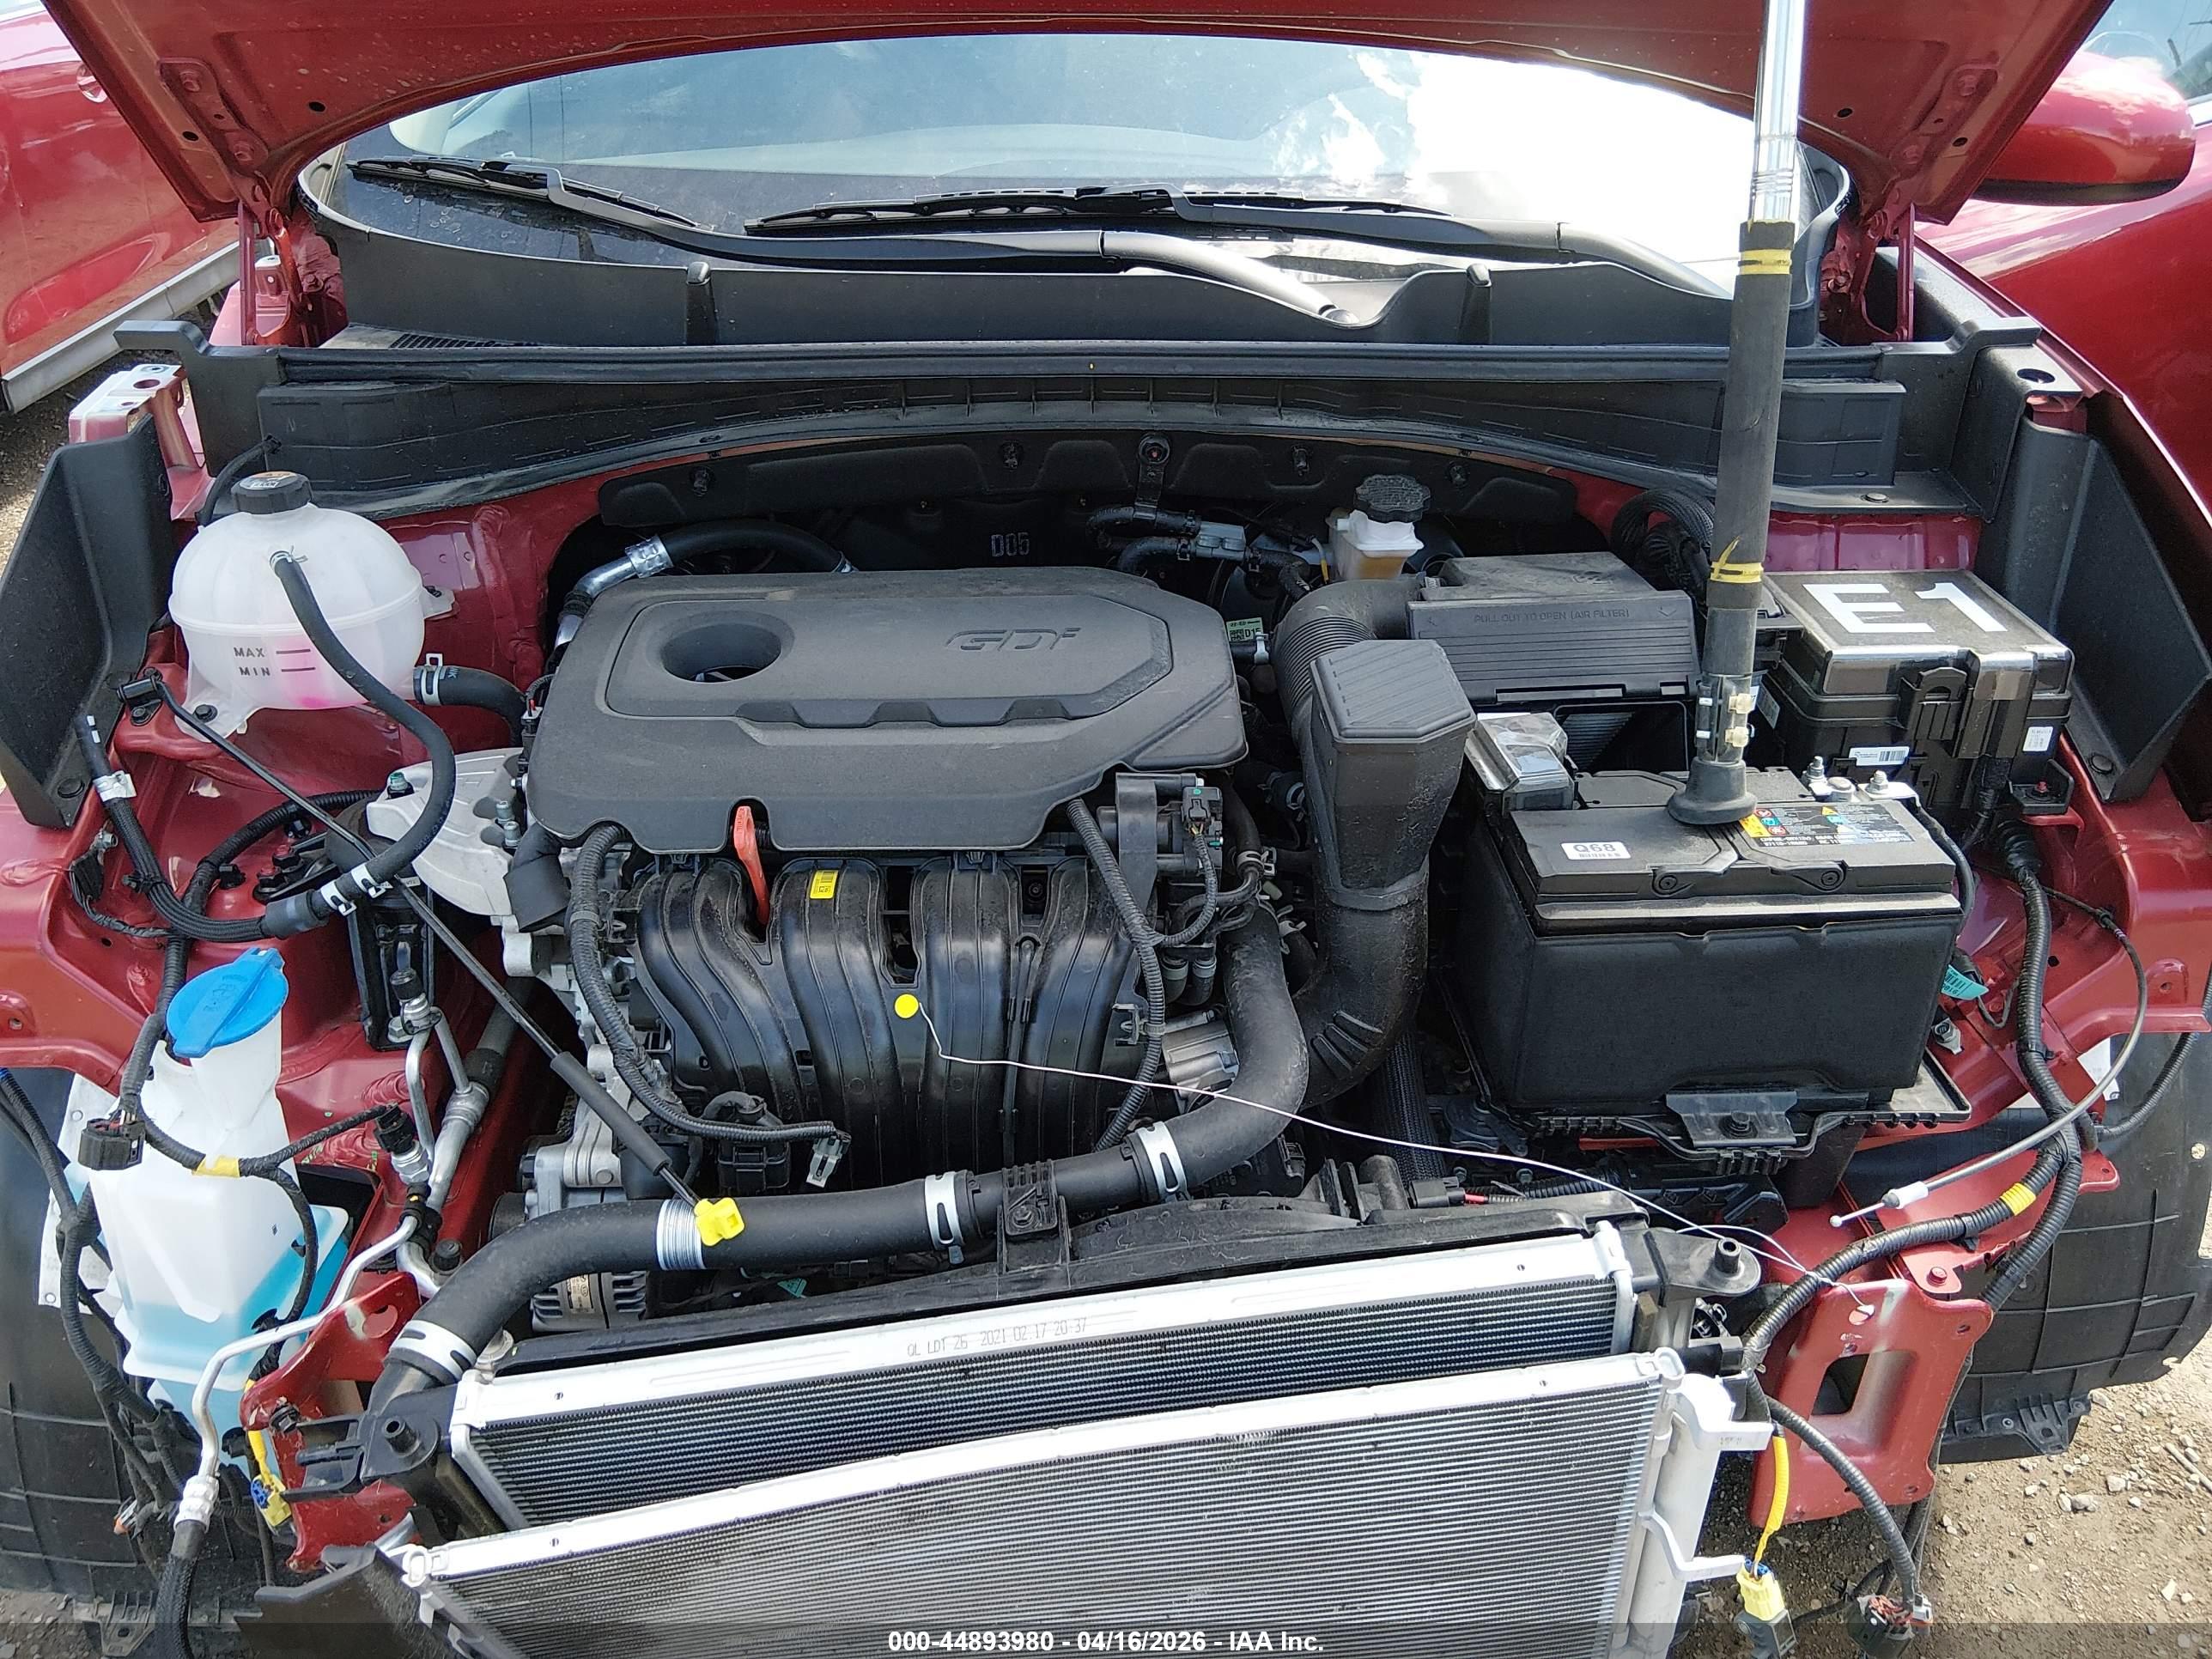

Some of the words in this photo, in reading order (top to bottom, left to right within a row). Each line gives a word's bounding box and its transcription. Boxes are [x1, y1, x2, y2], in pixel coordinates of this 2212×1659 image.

[1802, 583, 2008, 633] E1
[1474, 614, 1499, 623] PULL
[1502, 613, 1520, 623] OUT
[1523, 612, 1537, 621] TO
[1540, 611, 1566, 621] OPEN
[233, 647, 265, 658] MAX
[239, 666, 270, 677] MIN
[1572, 843, 1616, 853] Q68
[927, 1336, 948, 1354] LDT
[953, 1334, 968, 1350] 26
